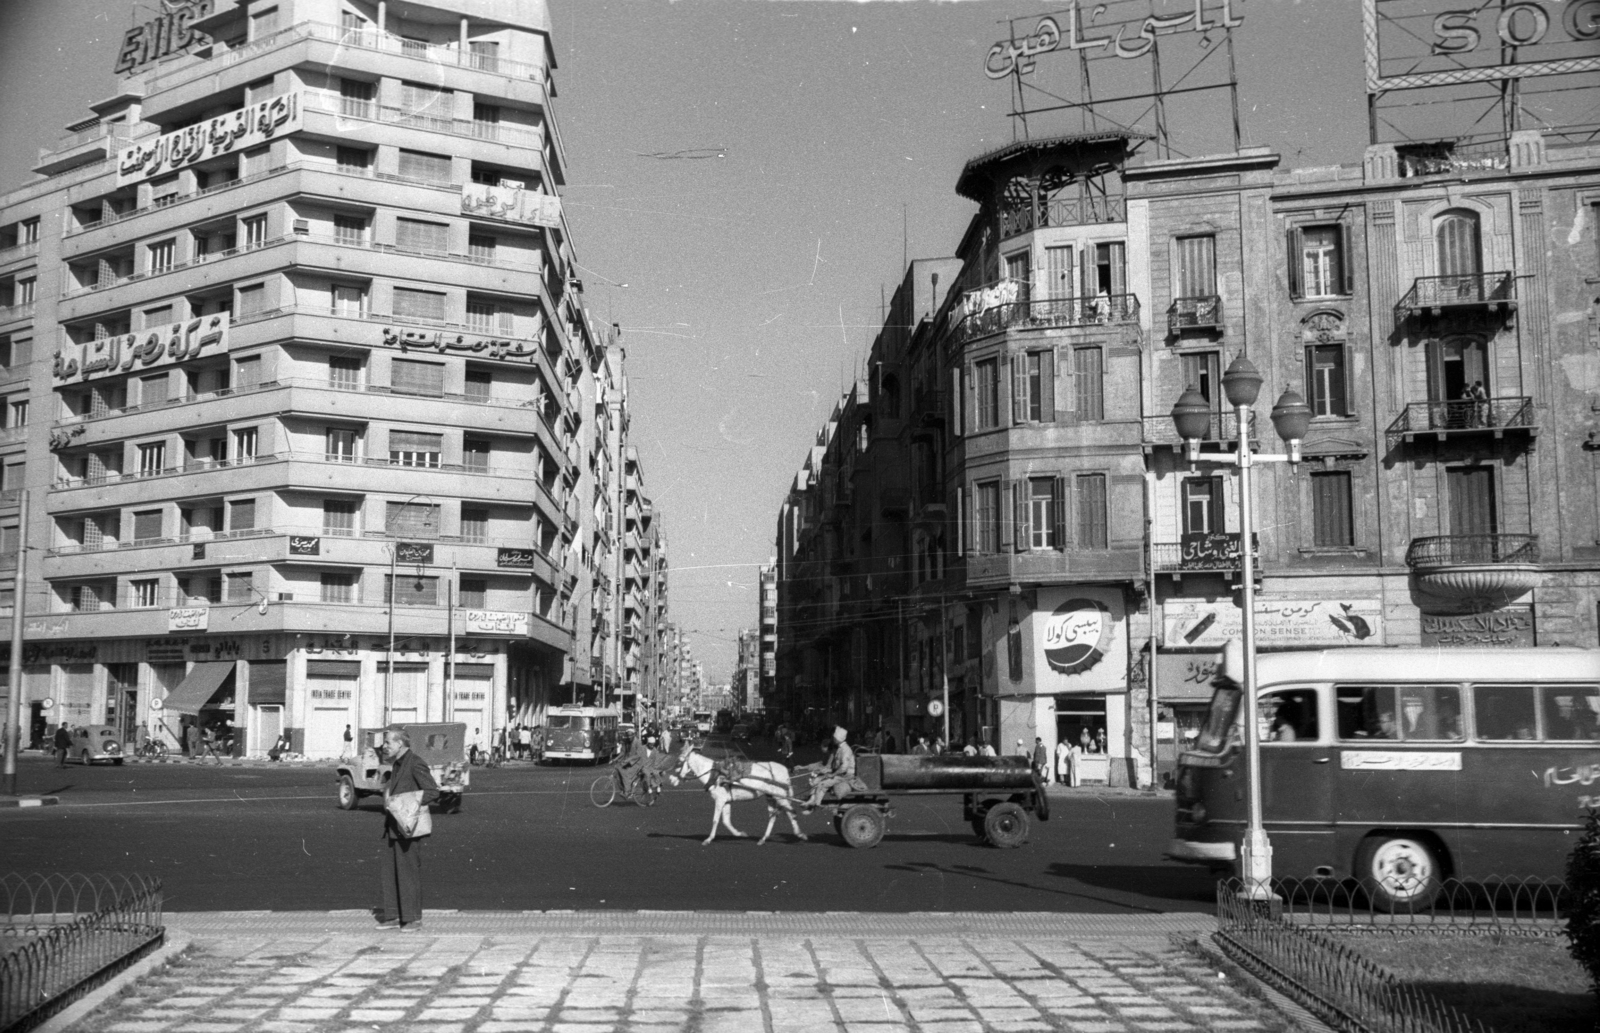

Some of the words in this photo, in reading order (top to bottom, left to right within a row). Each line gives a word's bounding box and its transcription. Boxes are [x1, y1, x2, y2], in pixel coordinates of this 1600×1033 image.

[984, 0, 1113, 80] شاهين
[256, 92, 297, 139] الشركة
[168, 316, 223, 361] شركة
[383, 327, 442, 354] للسياحة
[438, 335, 489, 354] مصر
[489, 339, 538, 363] شركة
[52, 336, 121, 383] للسياحة
[121, 333, 166, 372] مصر
[1207, 533, 1230, 541] دكتور
[1281, 602, 1322, 618] كومن
[478, 622, 516, 634] لبنان
[1046, 614, 1075, 645] كولا
[1221, 627, 1267, 636] COMON
[1270, 627, 1307, 636] SENSE
[323, 689, 336, 699] TRADE
